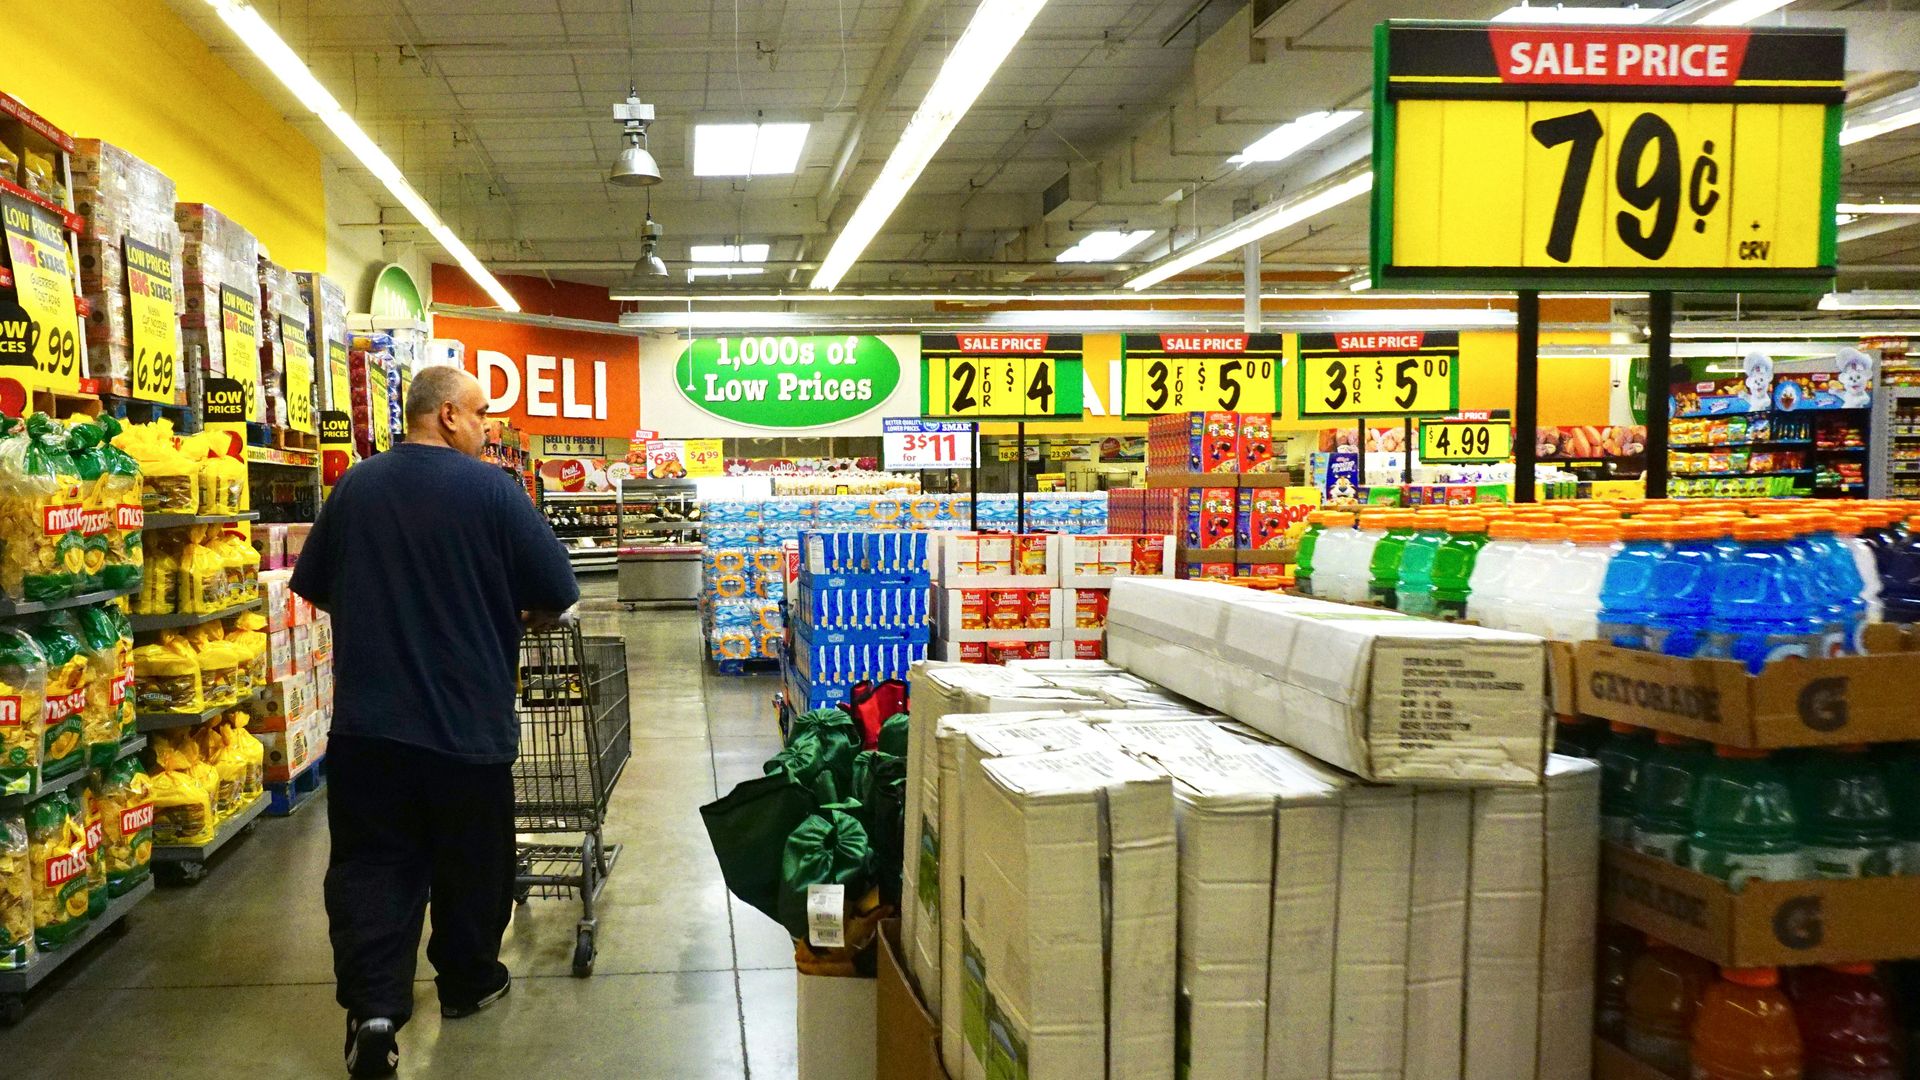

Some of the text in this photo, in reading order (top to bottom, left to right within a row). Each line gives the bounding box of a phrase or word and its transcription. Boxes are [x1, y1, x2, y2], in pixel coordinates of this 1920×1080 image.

[1510, 42, 1729, 77] SALE PRICE
[4, 205, 29, 231] LOW
[127, 245, 171, 277] LOW PRICES
[1739, 240, 1770, 261] CRV
[717, 336, 858, 371] 1,000s of
[964, 338, 1041, 350] SALE PRICE
[1167, 338, 1242, 350] SALE PRICE
[1341, 335, 1418, 349] SALE PRICE
[137, 348, 173, 395] 6.99
[477, 350, 607, 420] DELI
[704, 371, 871, 402] Low Prices
[952, 361, 976, 413] 2
[983, 366, 991, 407] FOR
[1146, 361, 1169, 411] 3
[1175, 366, 1183, 406] FOR
[1324, 361, 1347, 410] 3
[1353, 364, 1361, 404] FOR
[207, 391, 242, 404] LOW
[208, 405, 242, 414] PRICES
[1465, 412, 1488, 420] PRICE
[323, 420, 349, 430] LOW
[903, 434, 916, 451] 3
[1052, 450, 1071, 458] 23.99
[964, 592, 979, 600] Aunt
[995, 594, 1021, 606] Jemima
[1002, 592, 1018, 600] Aunt
[1590, 670, 1722, 723] GATORADE
[1798, 677, 1849, 731] G
[1774, 897, 1823, 949] G
